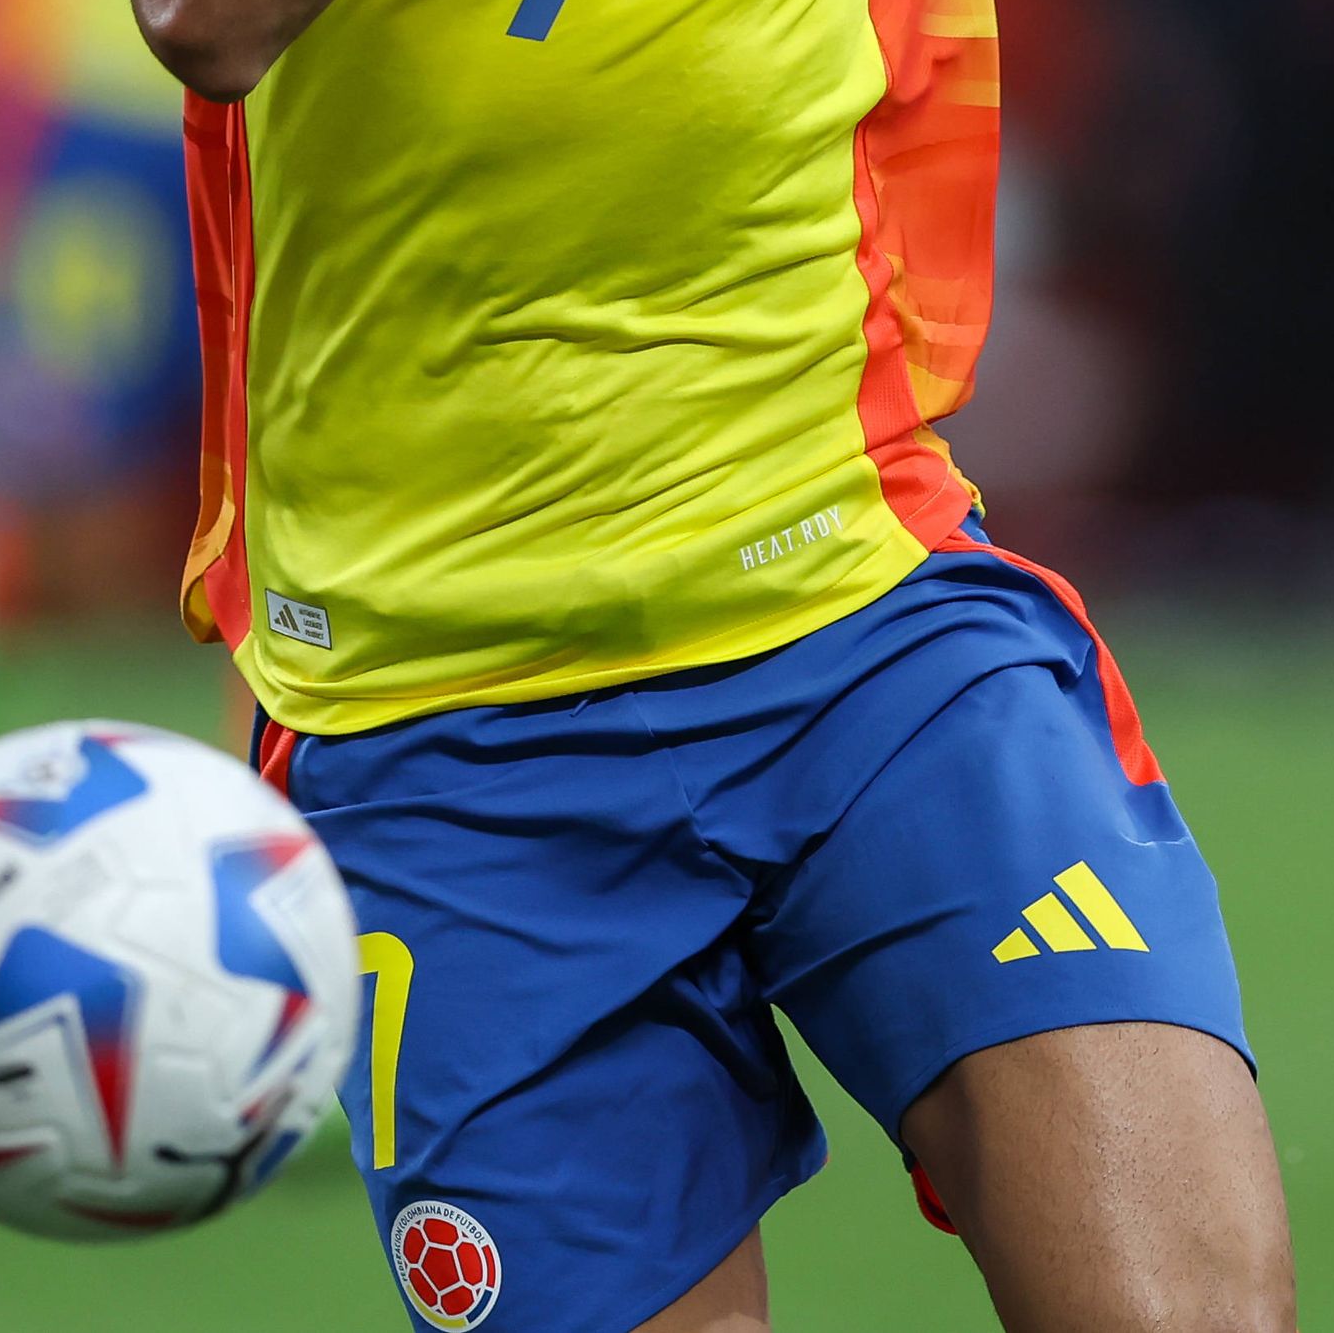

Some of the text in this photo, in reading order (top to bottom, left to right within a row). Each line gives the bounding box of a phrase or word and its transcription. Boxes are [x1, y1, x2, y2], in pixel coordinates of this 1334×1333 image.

[739, 505, 843, 571] HEAT.RDY
[354, 931, 414, 1170] 7
[443, 1208, 454, 1220] DE
[454, 1213, 485, 1245] FUTBOL
